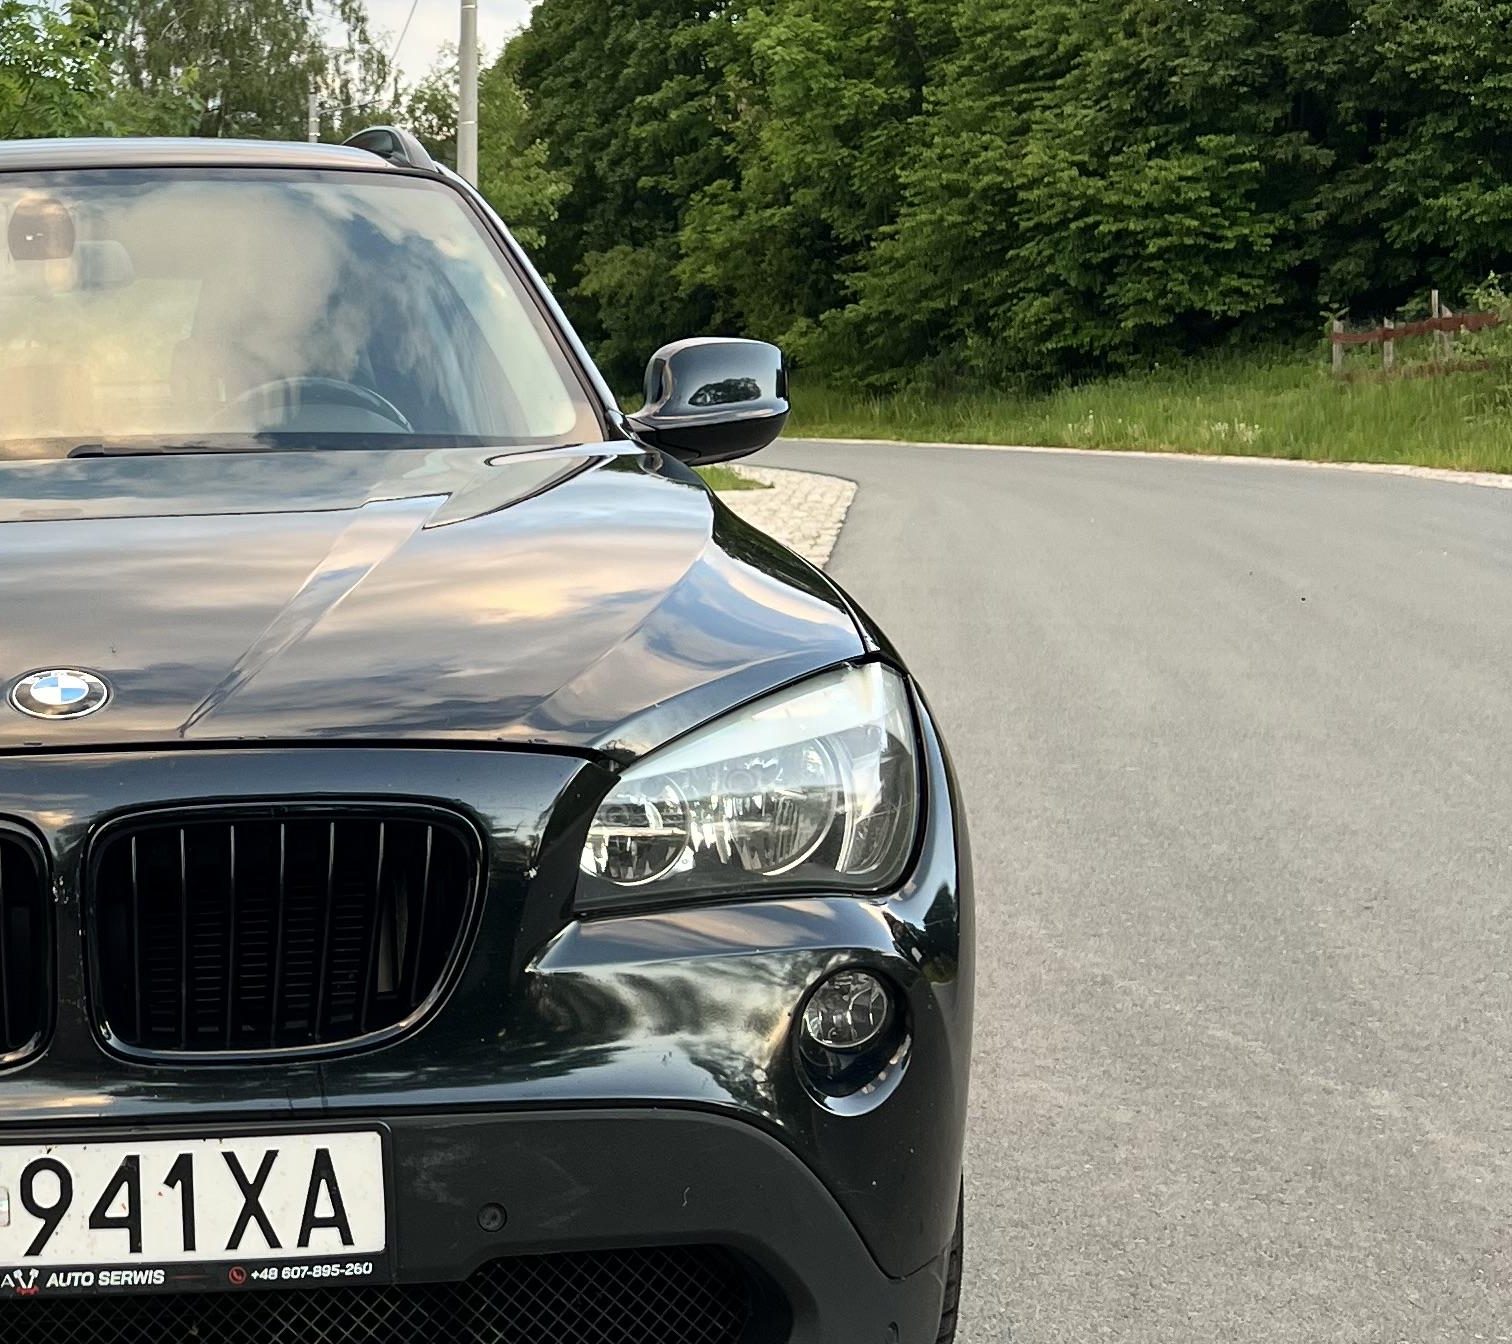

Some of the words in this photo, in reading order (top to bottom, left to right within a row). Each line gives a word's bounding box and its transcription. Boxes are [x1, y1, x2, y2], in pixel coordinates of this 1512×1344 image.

[19, 1148, 355, 1258] 941XA
[46, 1272, 95, 1288] AUTO
[98, 1269, 166, 1287] SERWIS
[250, 1267, 279, 1281] +48
[281, 1261, 373, 1280] 607-895-260
